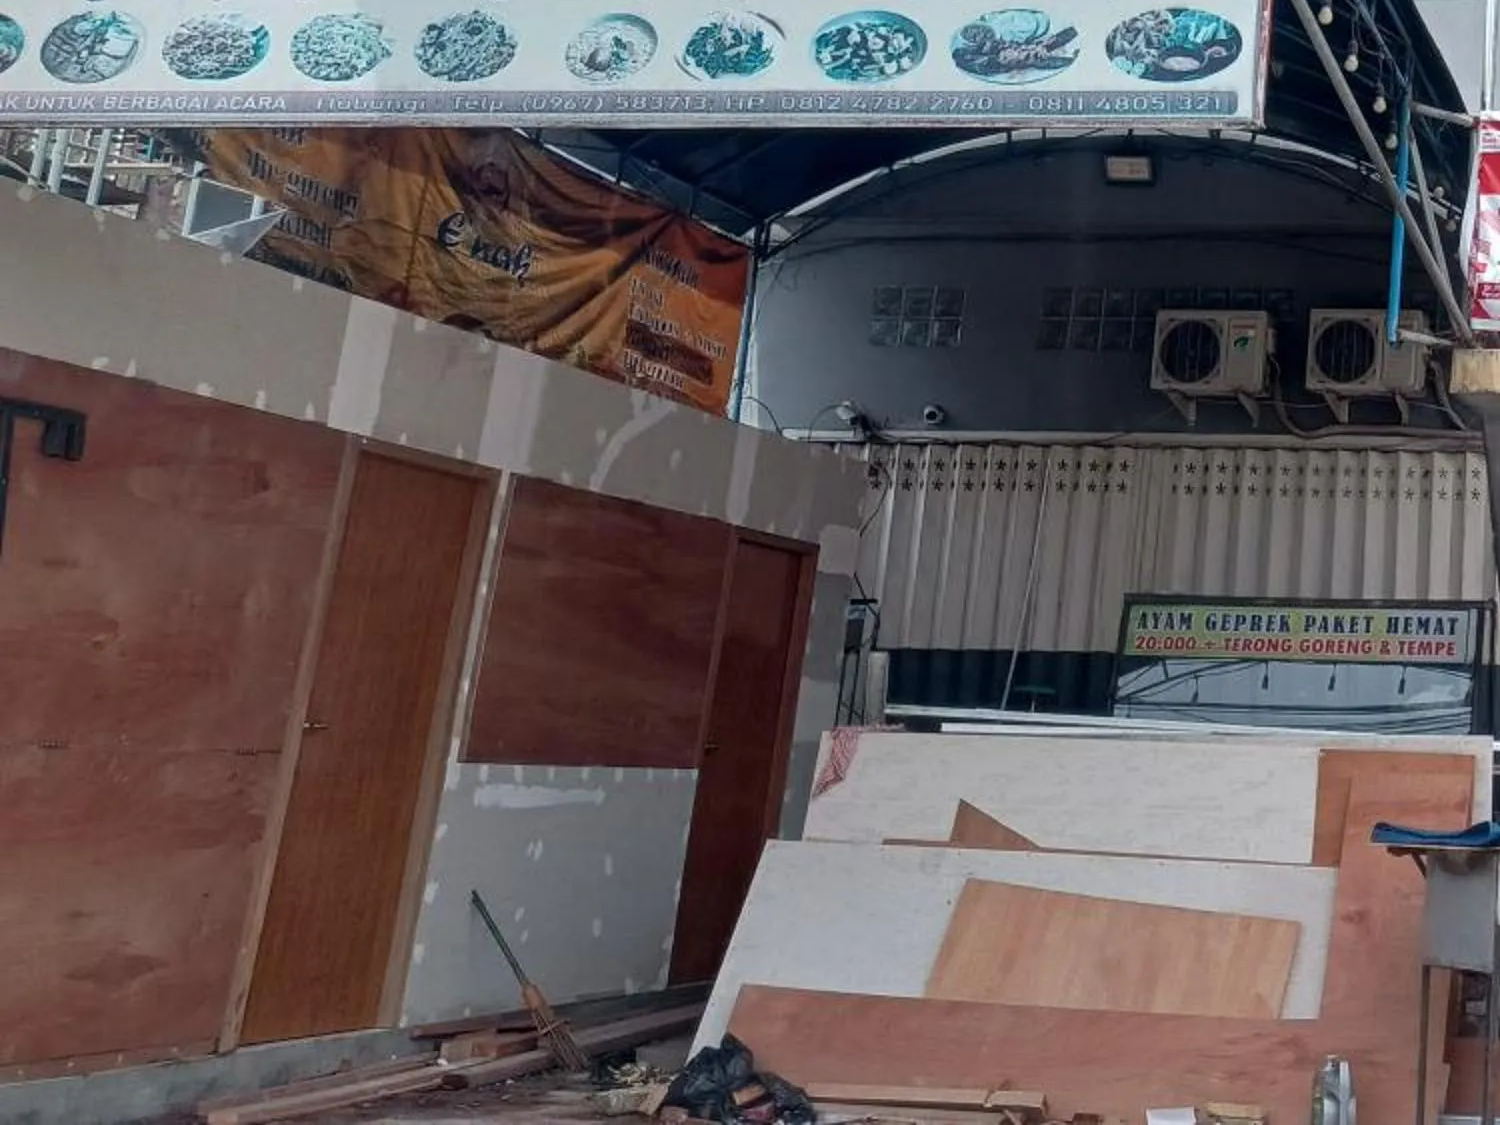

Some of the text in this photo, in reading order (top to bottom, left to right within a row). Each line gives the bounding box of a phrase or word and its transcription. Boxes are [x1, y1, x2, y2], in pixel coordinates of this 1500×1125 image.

[0, 94, 19, 111] K
[25, 94, 96, 111] UNTUK
[102, 94, 209, 111] BERBAGAI
[215, 95, 288, 111] ACARA
[521, 94, 604, 112] (0967)
[780, 96, 841, 111] 0812
[1027, 96, 1086, 111] 0811
[1095, 96, 1167, 111] 4805
[1177, 96, 1223, 111] 321
[1136, 611, 1193, 631] AYAM
[1304, 614, 1375, 634] PAKET
[1387, 616, 1459, 635] HEMAT
[1222, 638, 1293, 653] TERONG
[1300, 640, 1373, 655] GORENG
[1398, 641, 1457, 656] TEMPE
